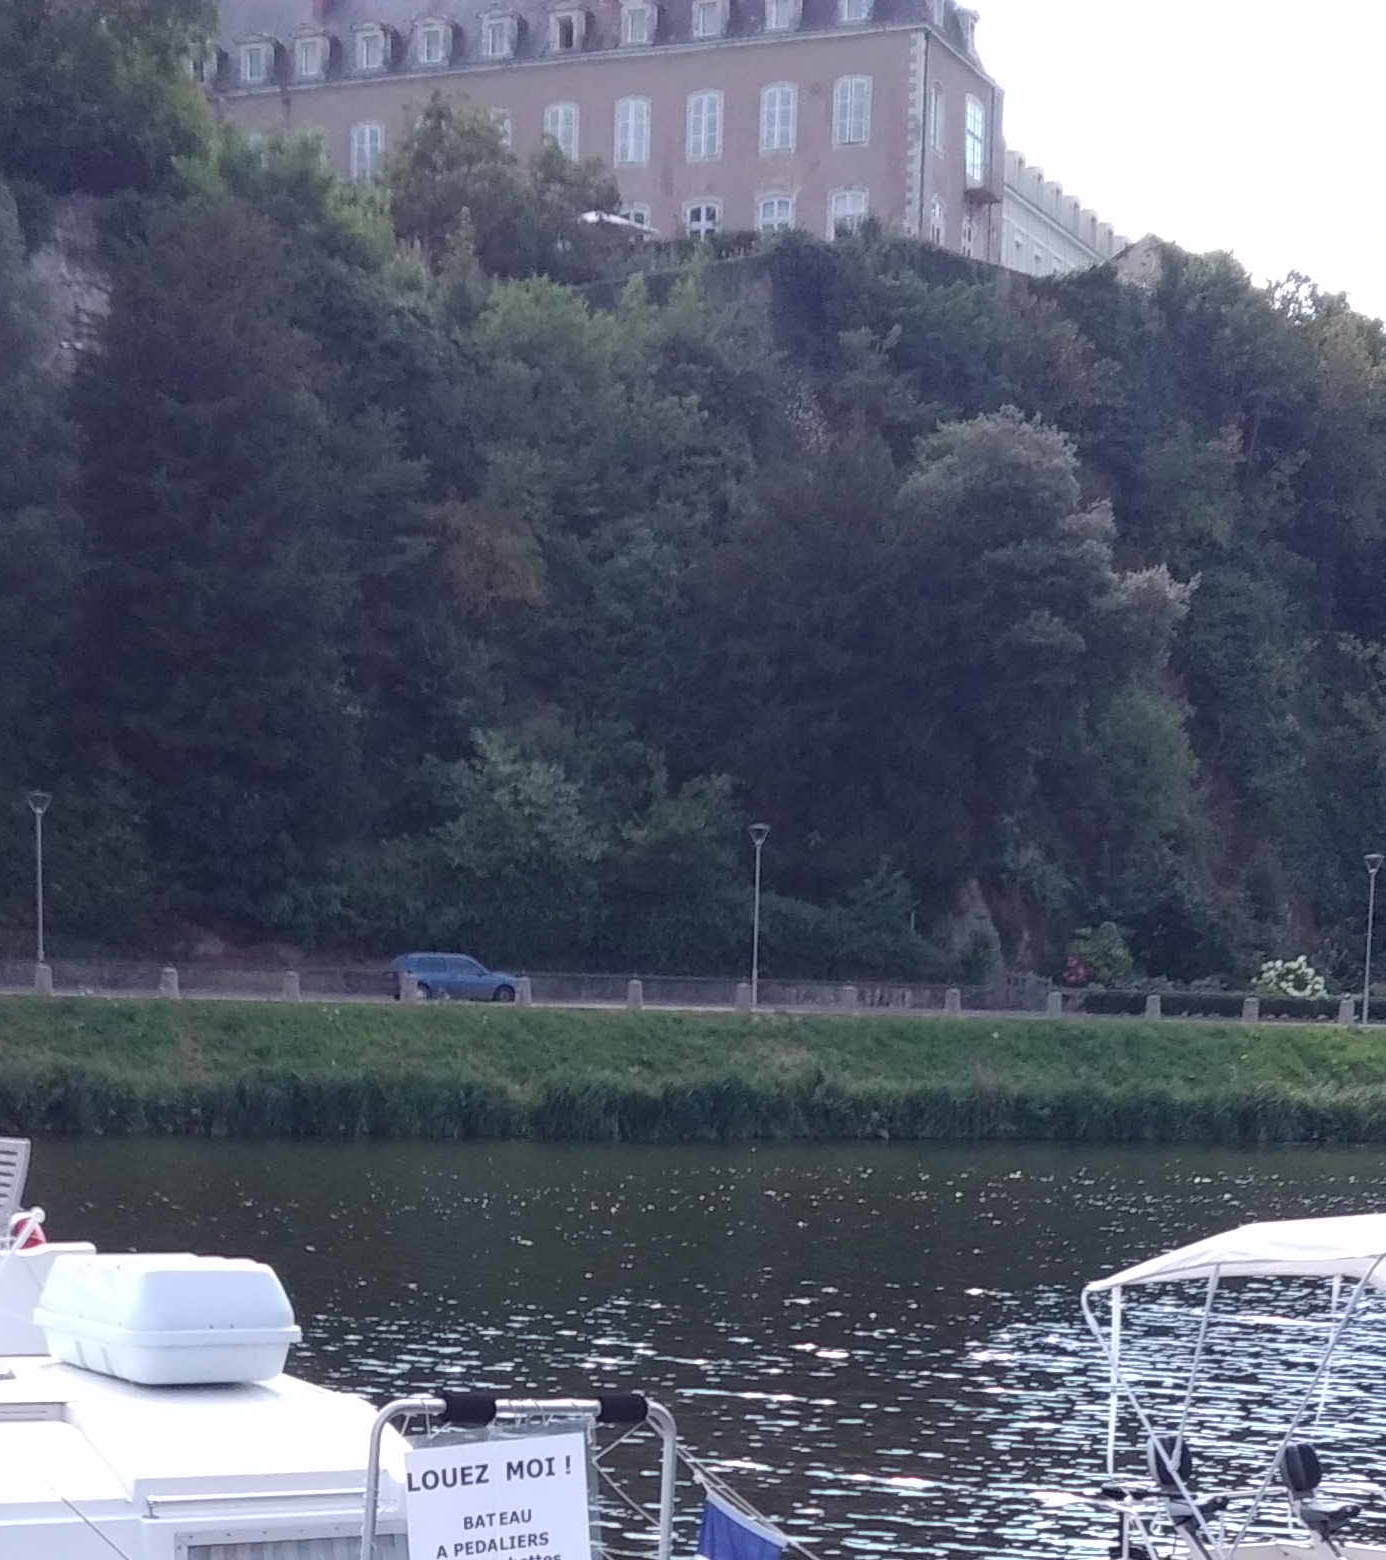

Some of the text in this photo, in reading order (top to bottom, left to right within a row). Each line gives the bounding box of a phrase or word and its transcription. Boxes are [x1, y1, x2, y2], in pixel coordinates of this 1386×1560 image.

[407, 1464, 490, 1492] LOUEZ
[506, 1457, 556, 1481] MOI
[463, 1509, 532, 1530] BATEAU
[436, 1532, 549, 1560] A PEDALIERS
